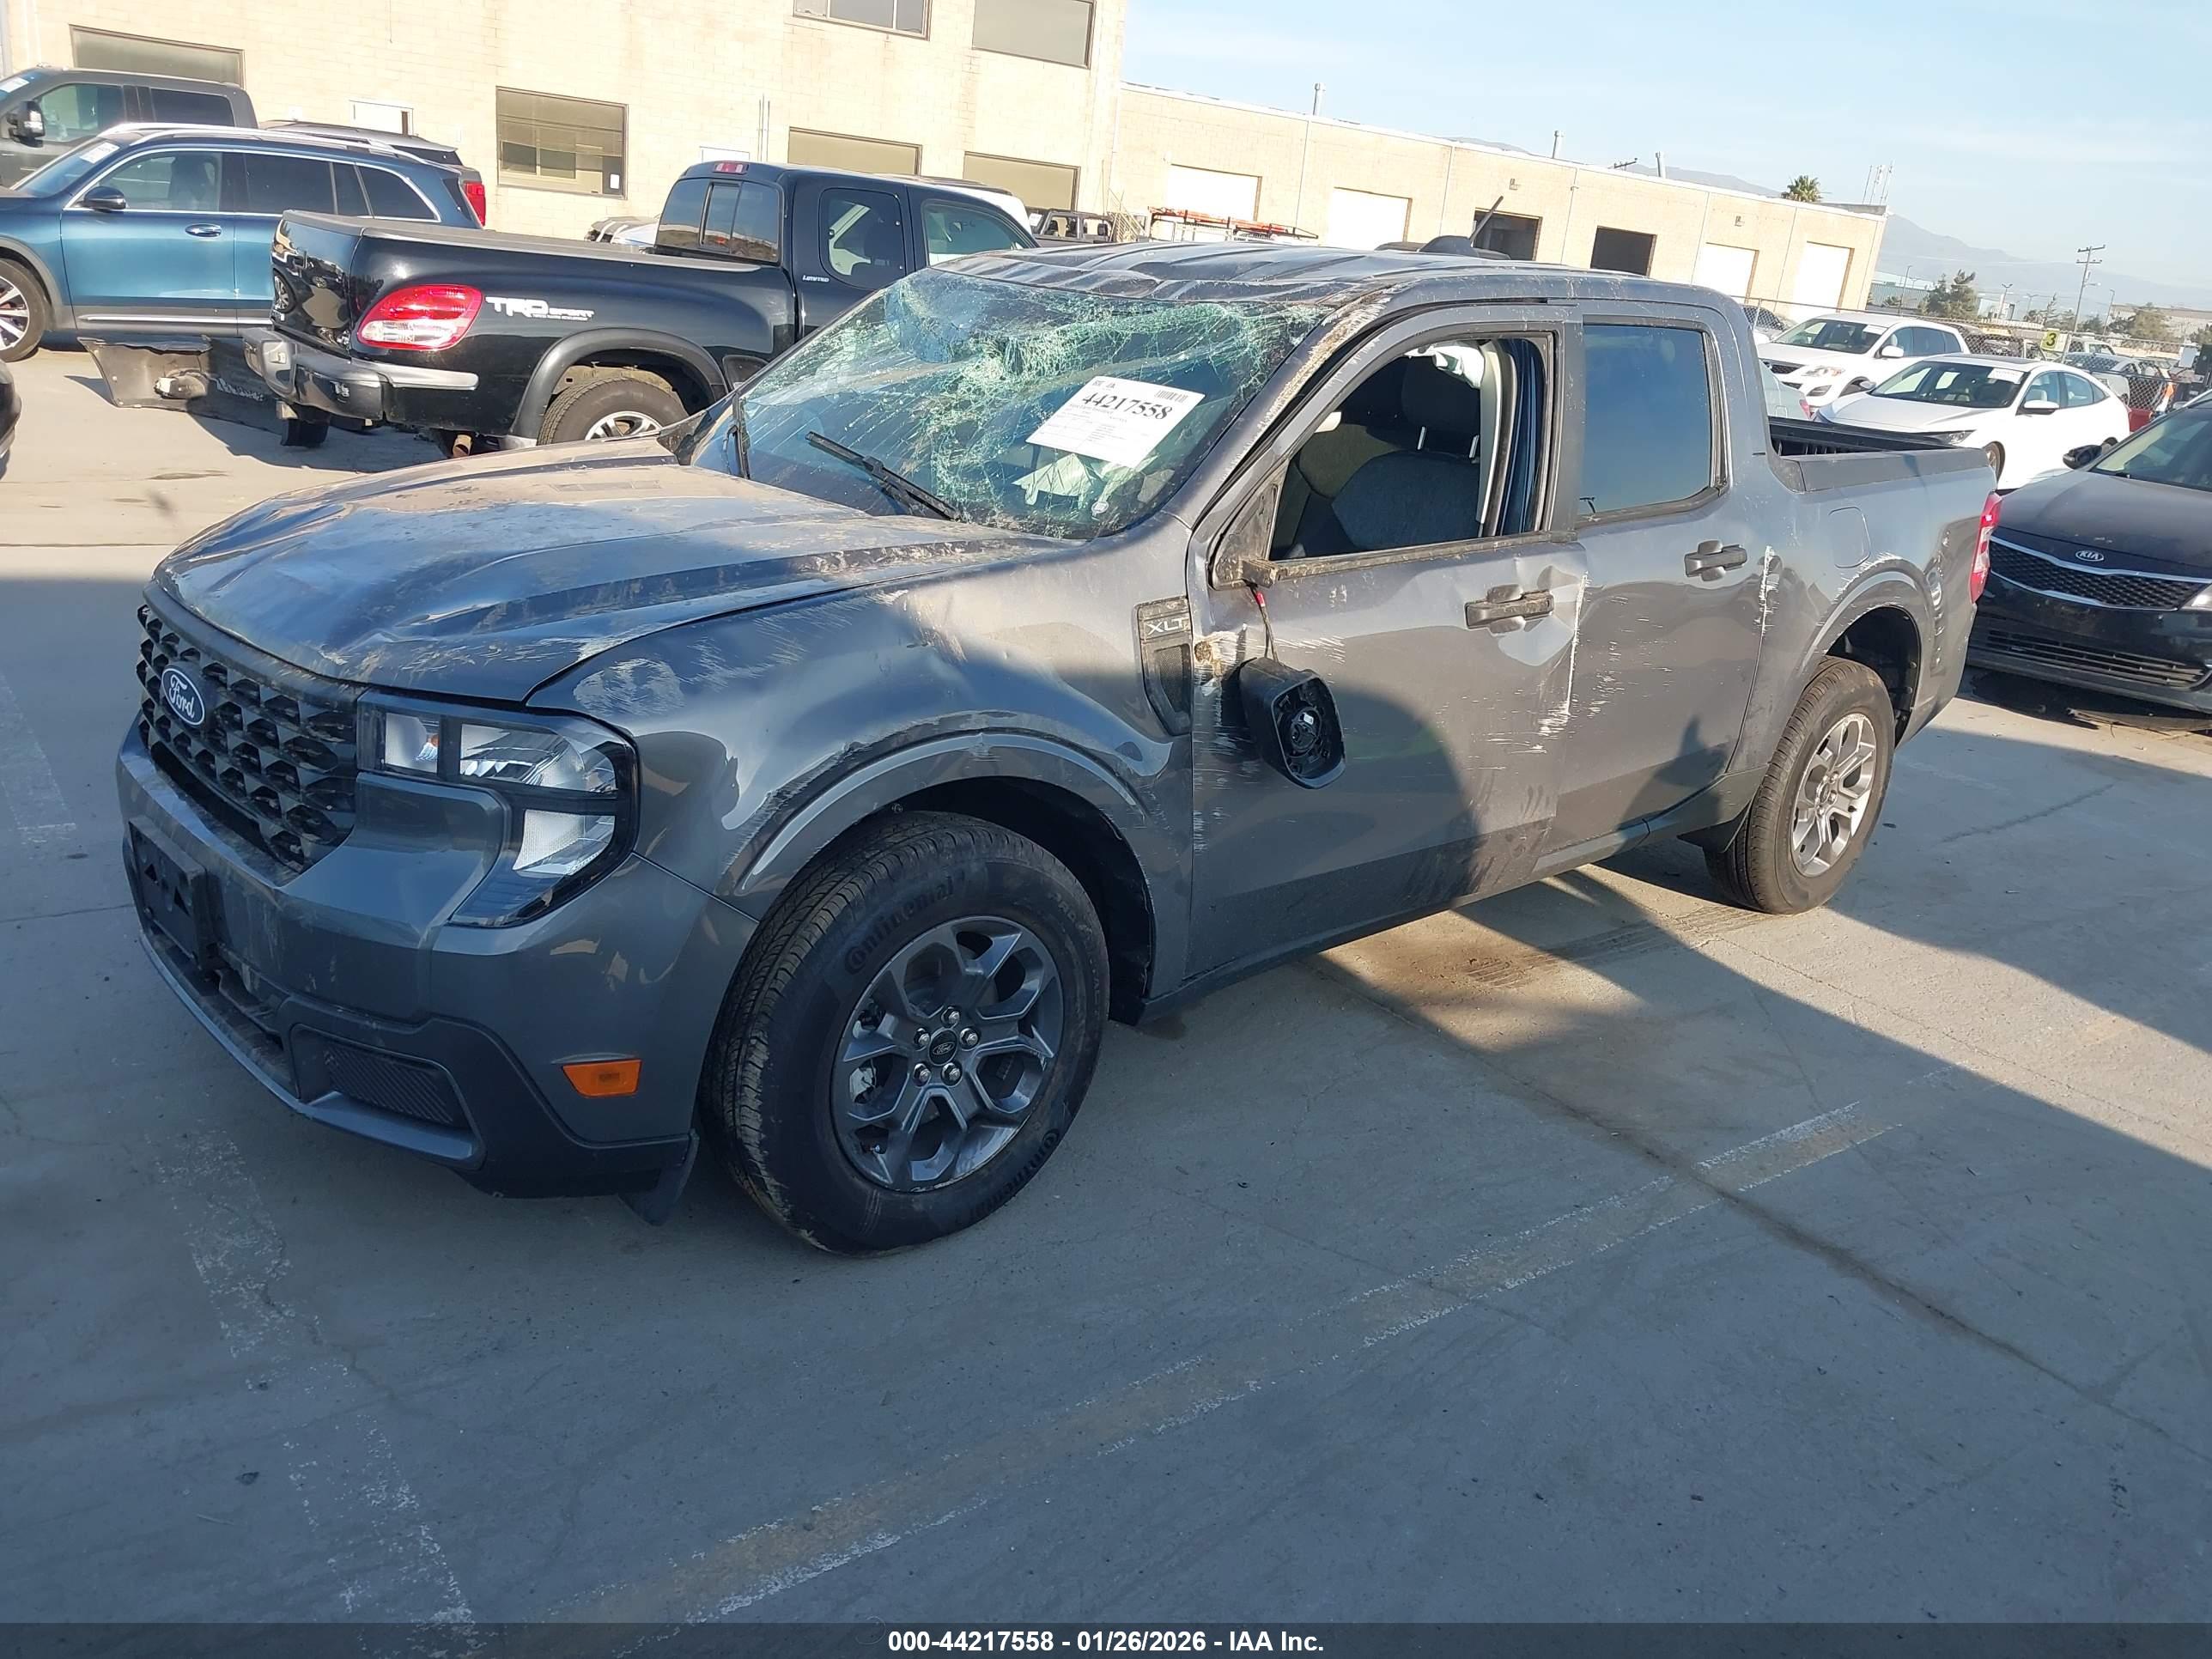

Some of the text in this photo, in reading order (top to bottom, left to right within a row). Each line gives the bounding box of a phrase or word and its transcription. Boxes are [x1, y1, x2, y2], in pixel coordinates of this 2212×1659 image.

[484, 296, 549, 318] TRD
[2046, 332, 2057, 346] 3
[1082, 392, 1173, 420] 44217558
[2078, 550, 2100, 561] KIA
[1146, 617, 1188, 636] XLT
[167, 673, 197, 720] Ford
